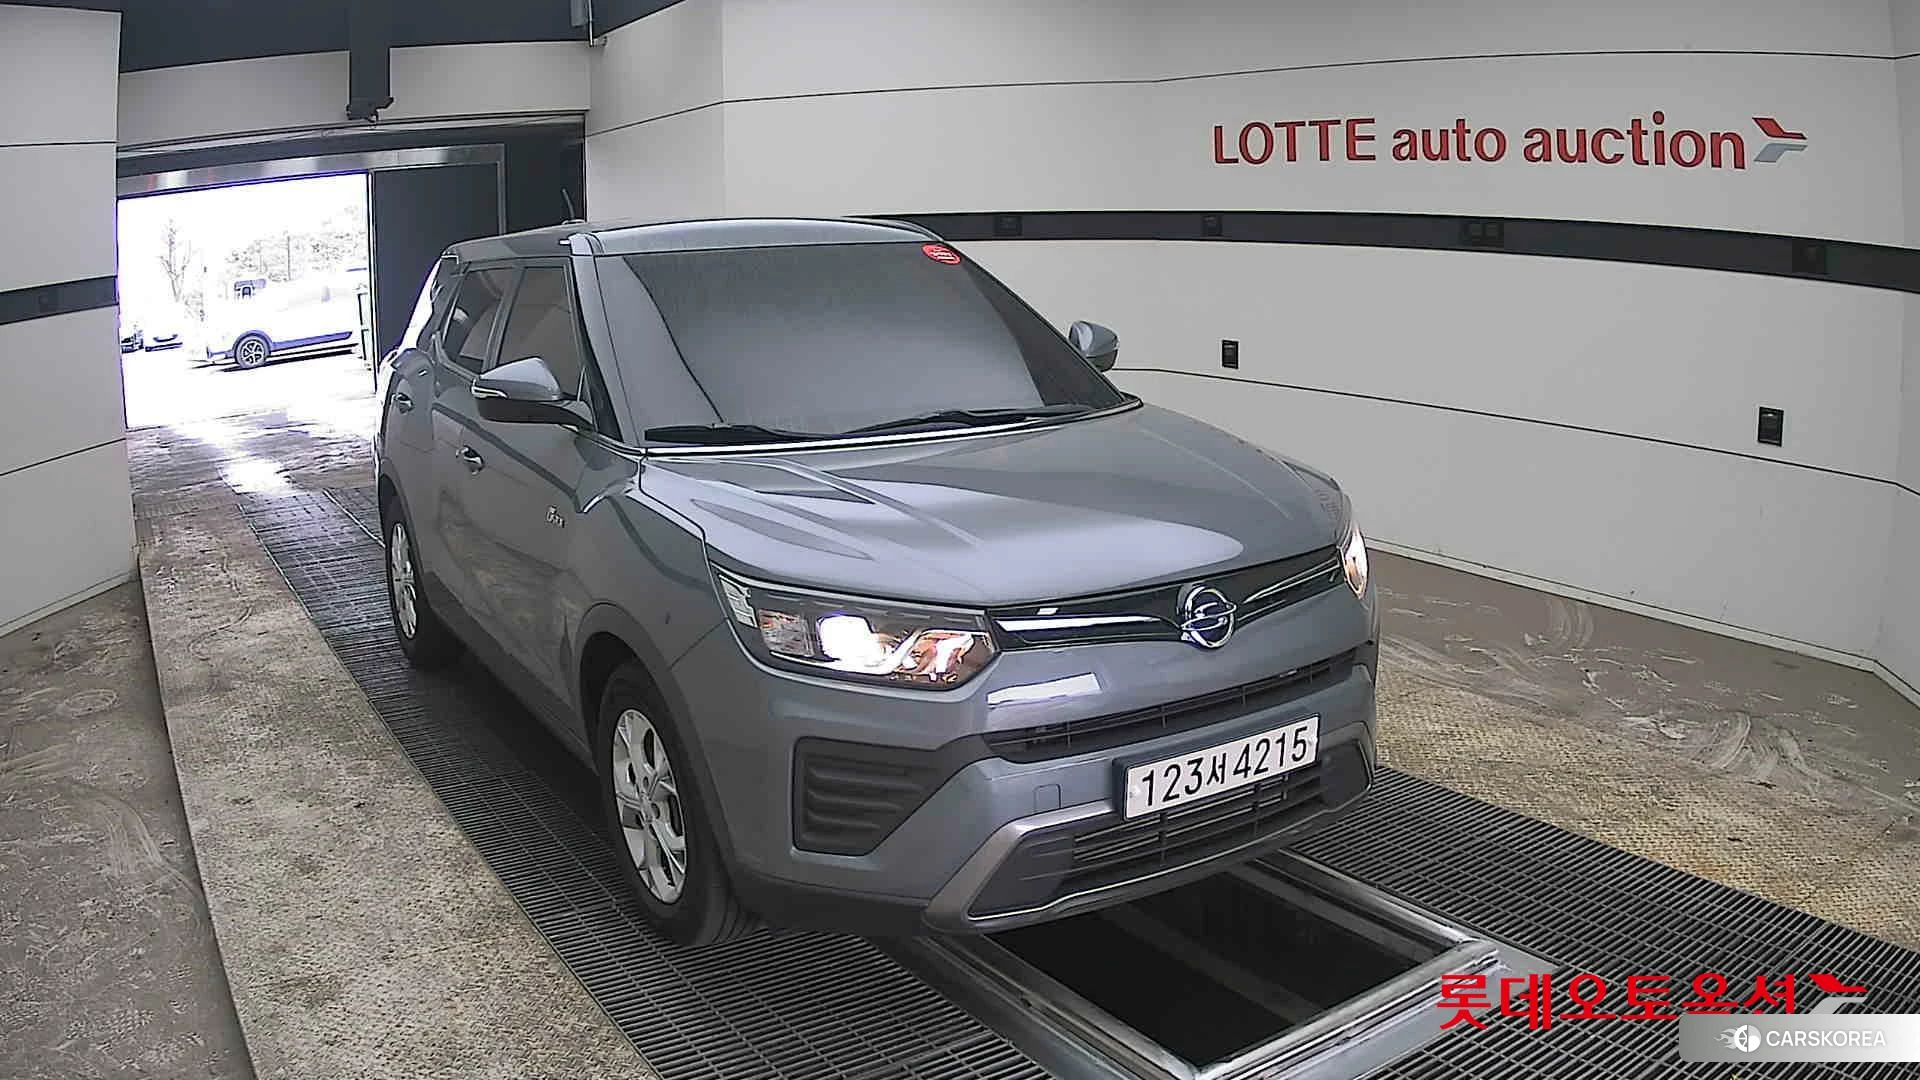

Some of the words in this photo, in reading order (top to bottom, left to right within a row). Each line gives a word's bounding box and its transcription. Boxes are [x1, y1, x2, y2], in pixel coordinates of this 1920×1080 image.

[1213, 118, 1376, 164] LOTTE
[1392, 118, 1507, 163] auto
[1523, 110, 1746, 169] auction
